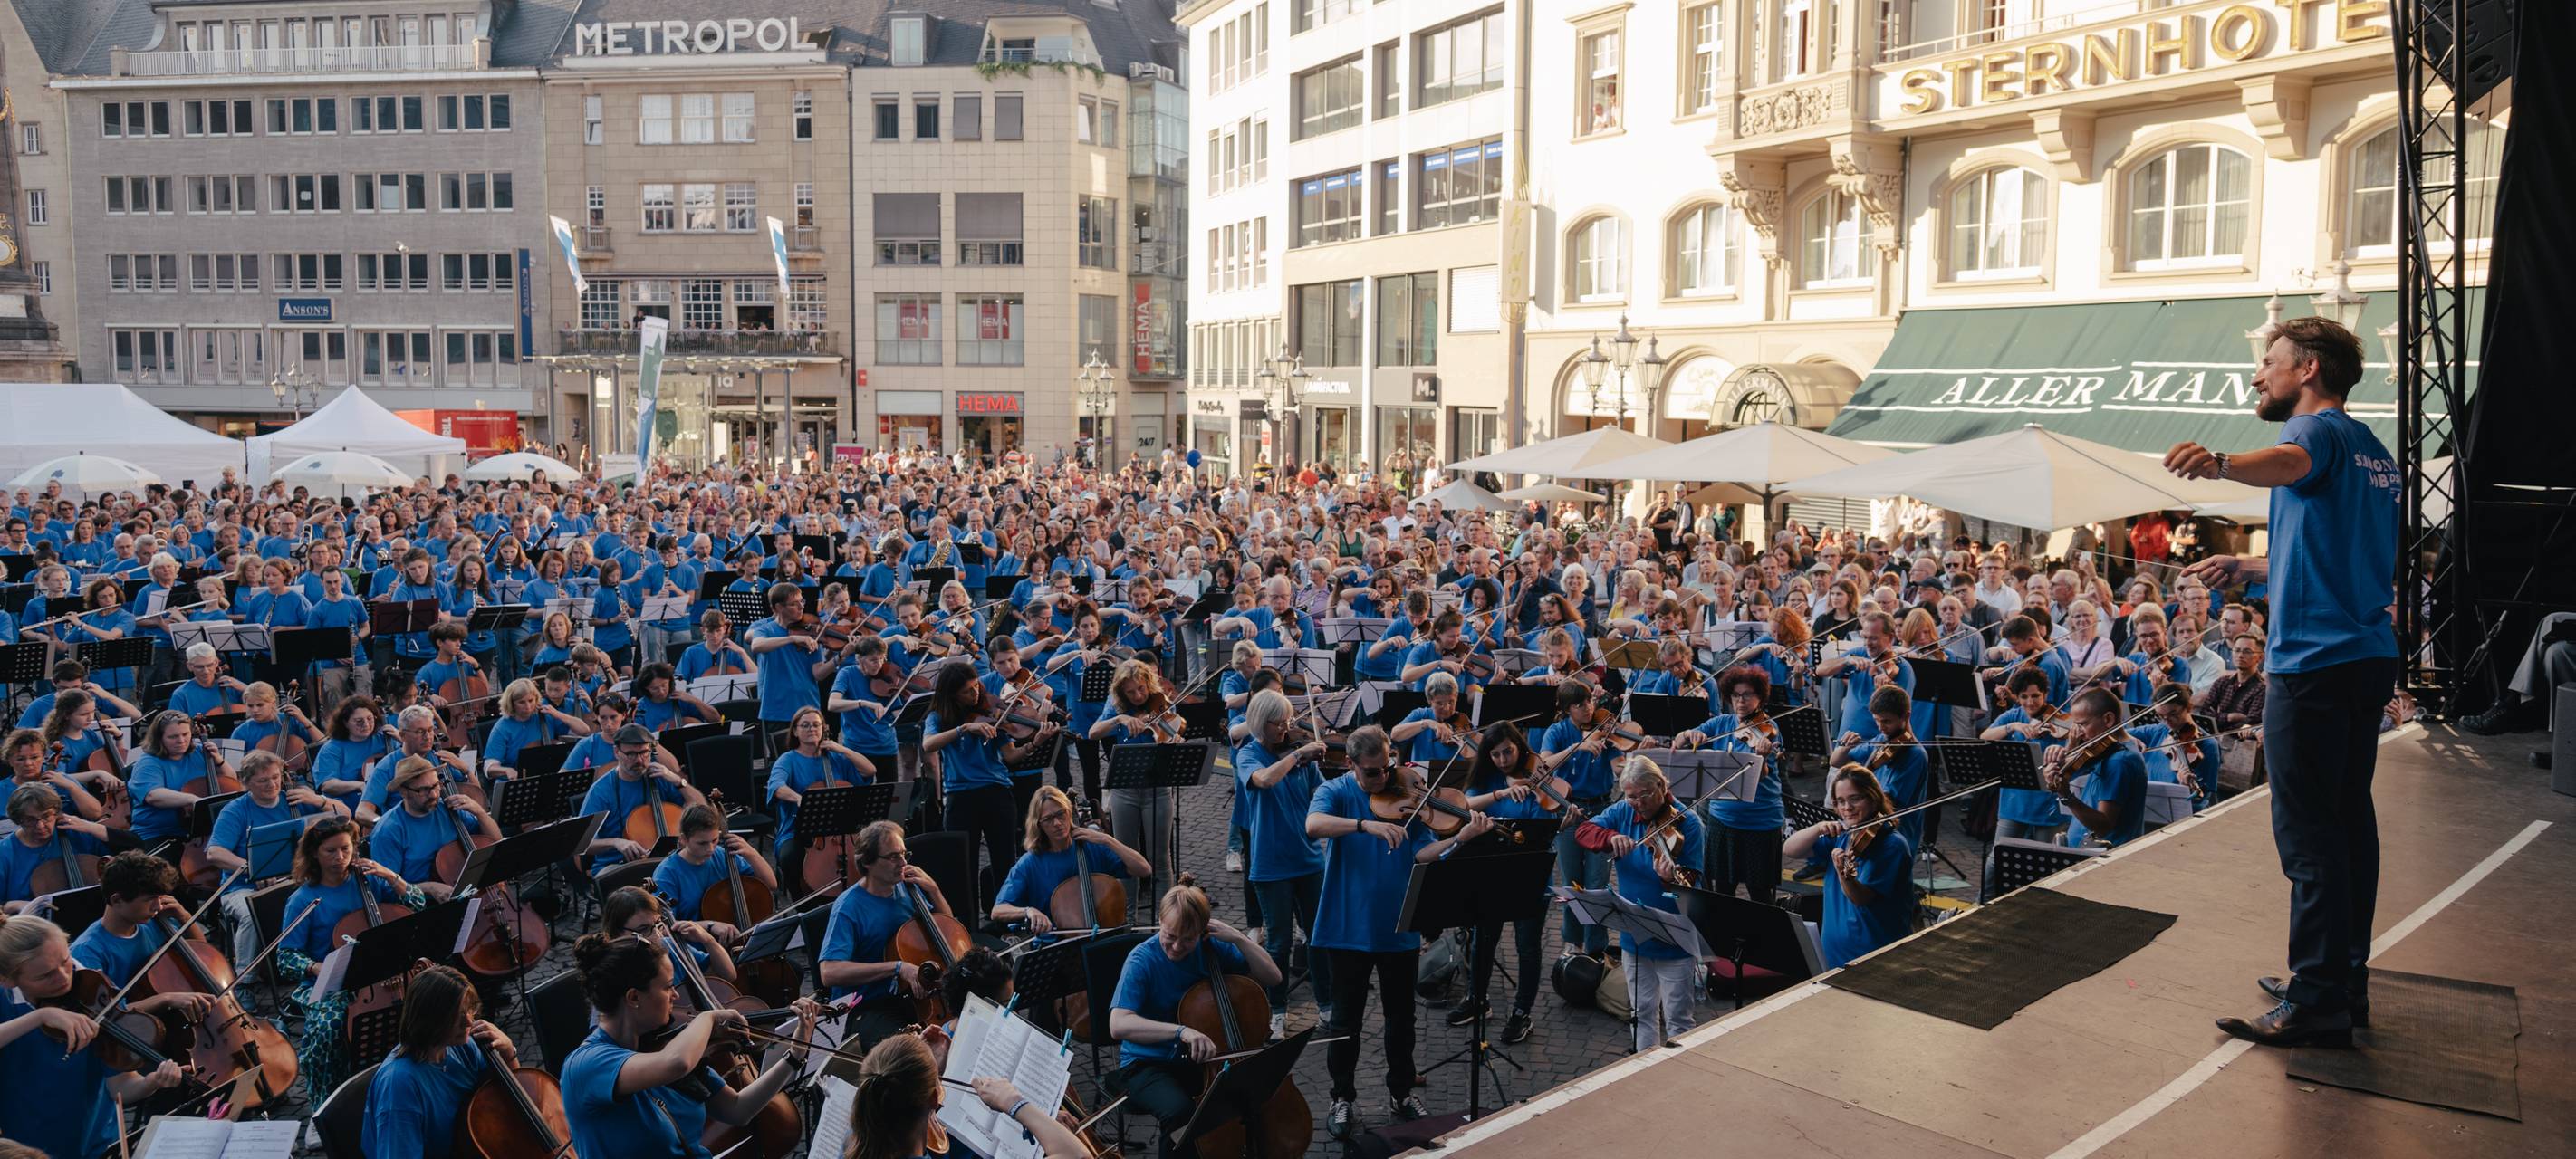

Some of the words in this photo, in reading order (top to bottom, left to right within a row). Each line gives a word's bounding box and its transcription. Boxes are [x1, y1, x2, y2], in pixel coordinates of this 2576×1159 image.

[575, 17, 818, 56] METROPOL
[1900, 0, 2386, 115] STERNHOTE
[282, 302, 329, 316] ANSON'S
[1137, 302, 1150, 357] HEMA
[958, 394, 1019, 413] HEMA
[1931, 375, 2105, 407] ALLER
[2111, 370, 2257, 407] MAN
[1138, 436, 1156, 447] 24/7
